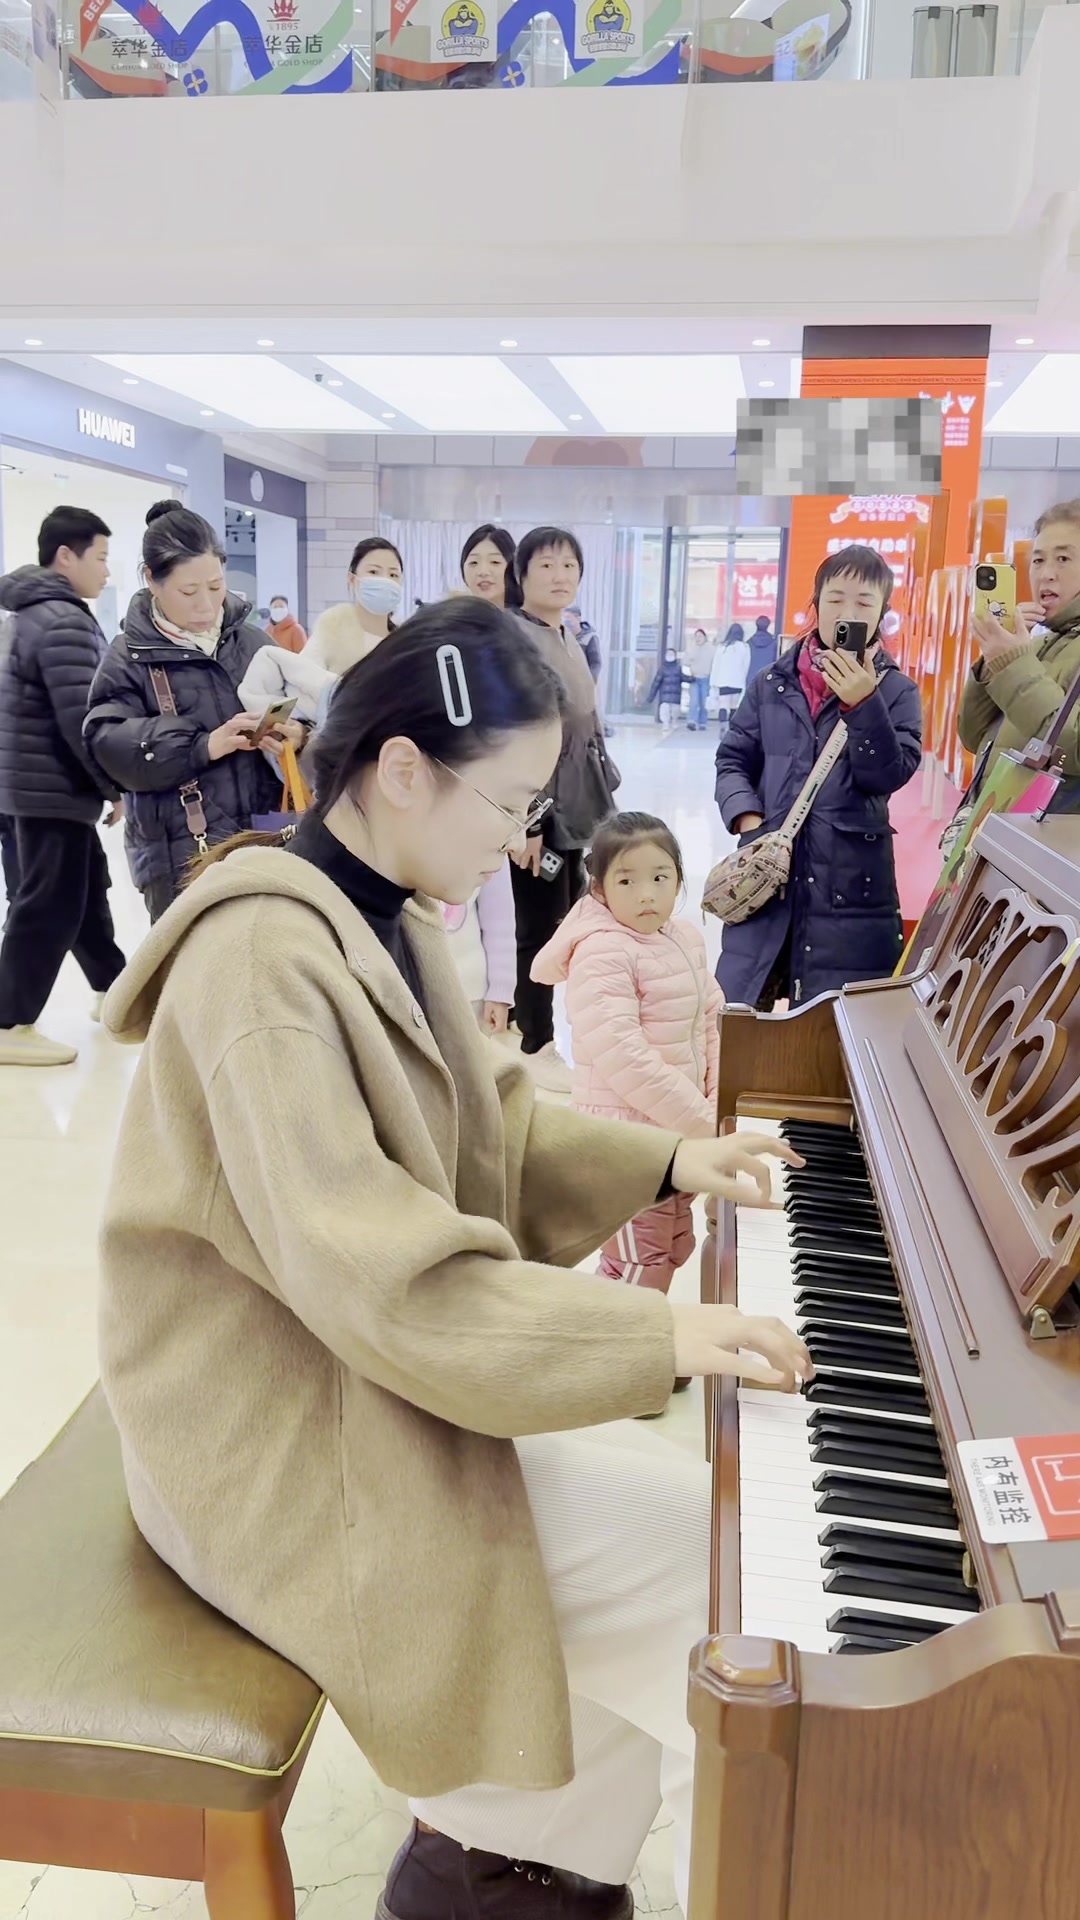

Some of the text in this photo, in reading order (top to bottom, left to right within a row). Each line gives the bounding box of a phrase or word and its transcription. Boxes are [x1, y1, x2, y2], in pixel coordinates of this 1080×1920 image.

[112, 38, 188, 58] 萃华金店
[464, 36, 489, 49] SPORTS
[609, 31, 635, 45] SPORTS
[79, 407, 135, 448] HUAWEI
[982, 1456, 1032, 1525] 内有监控
